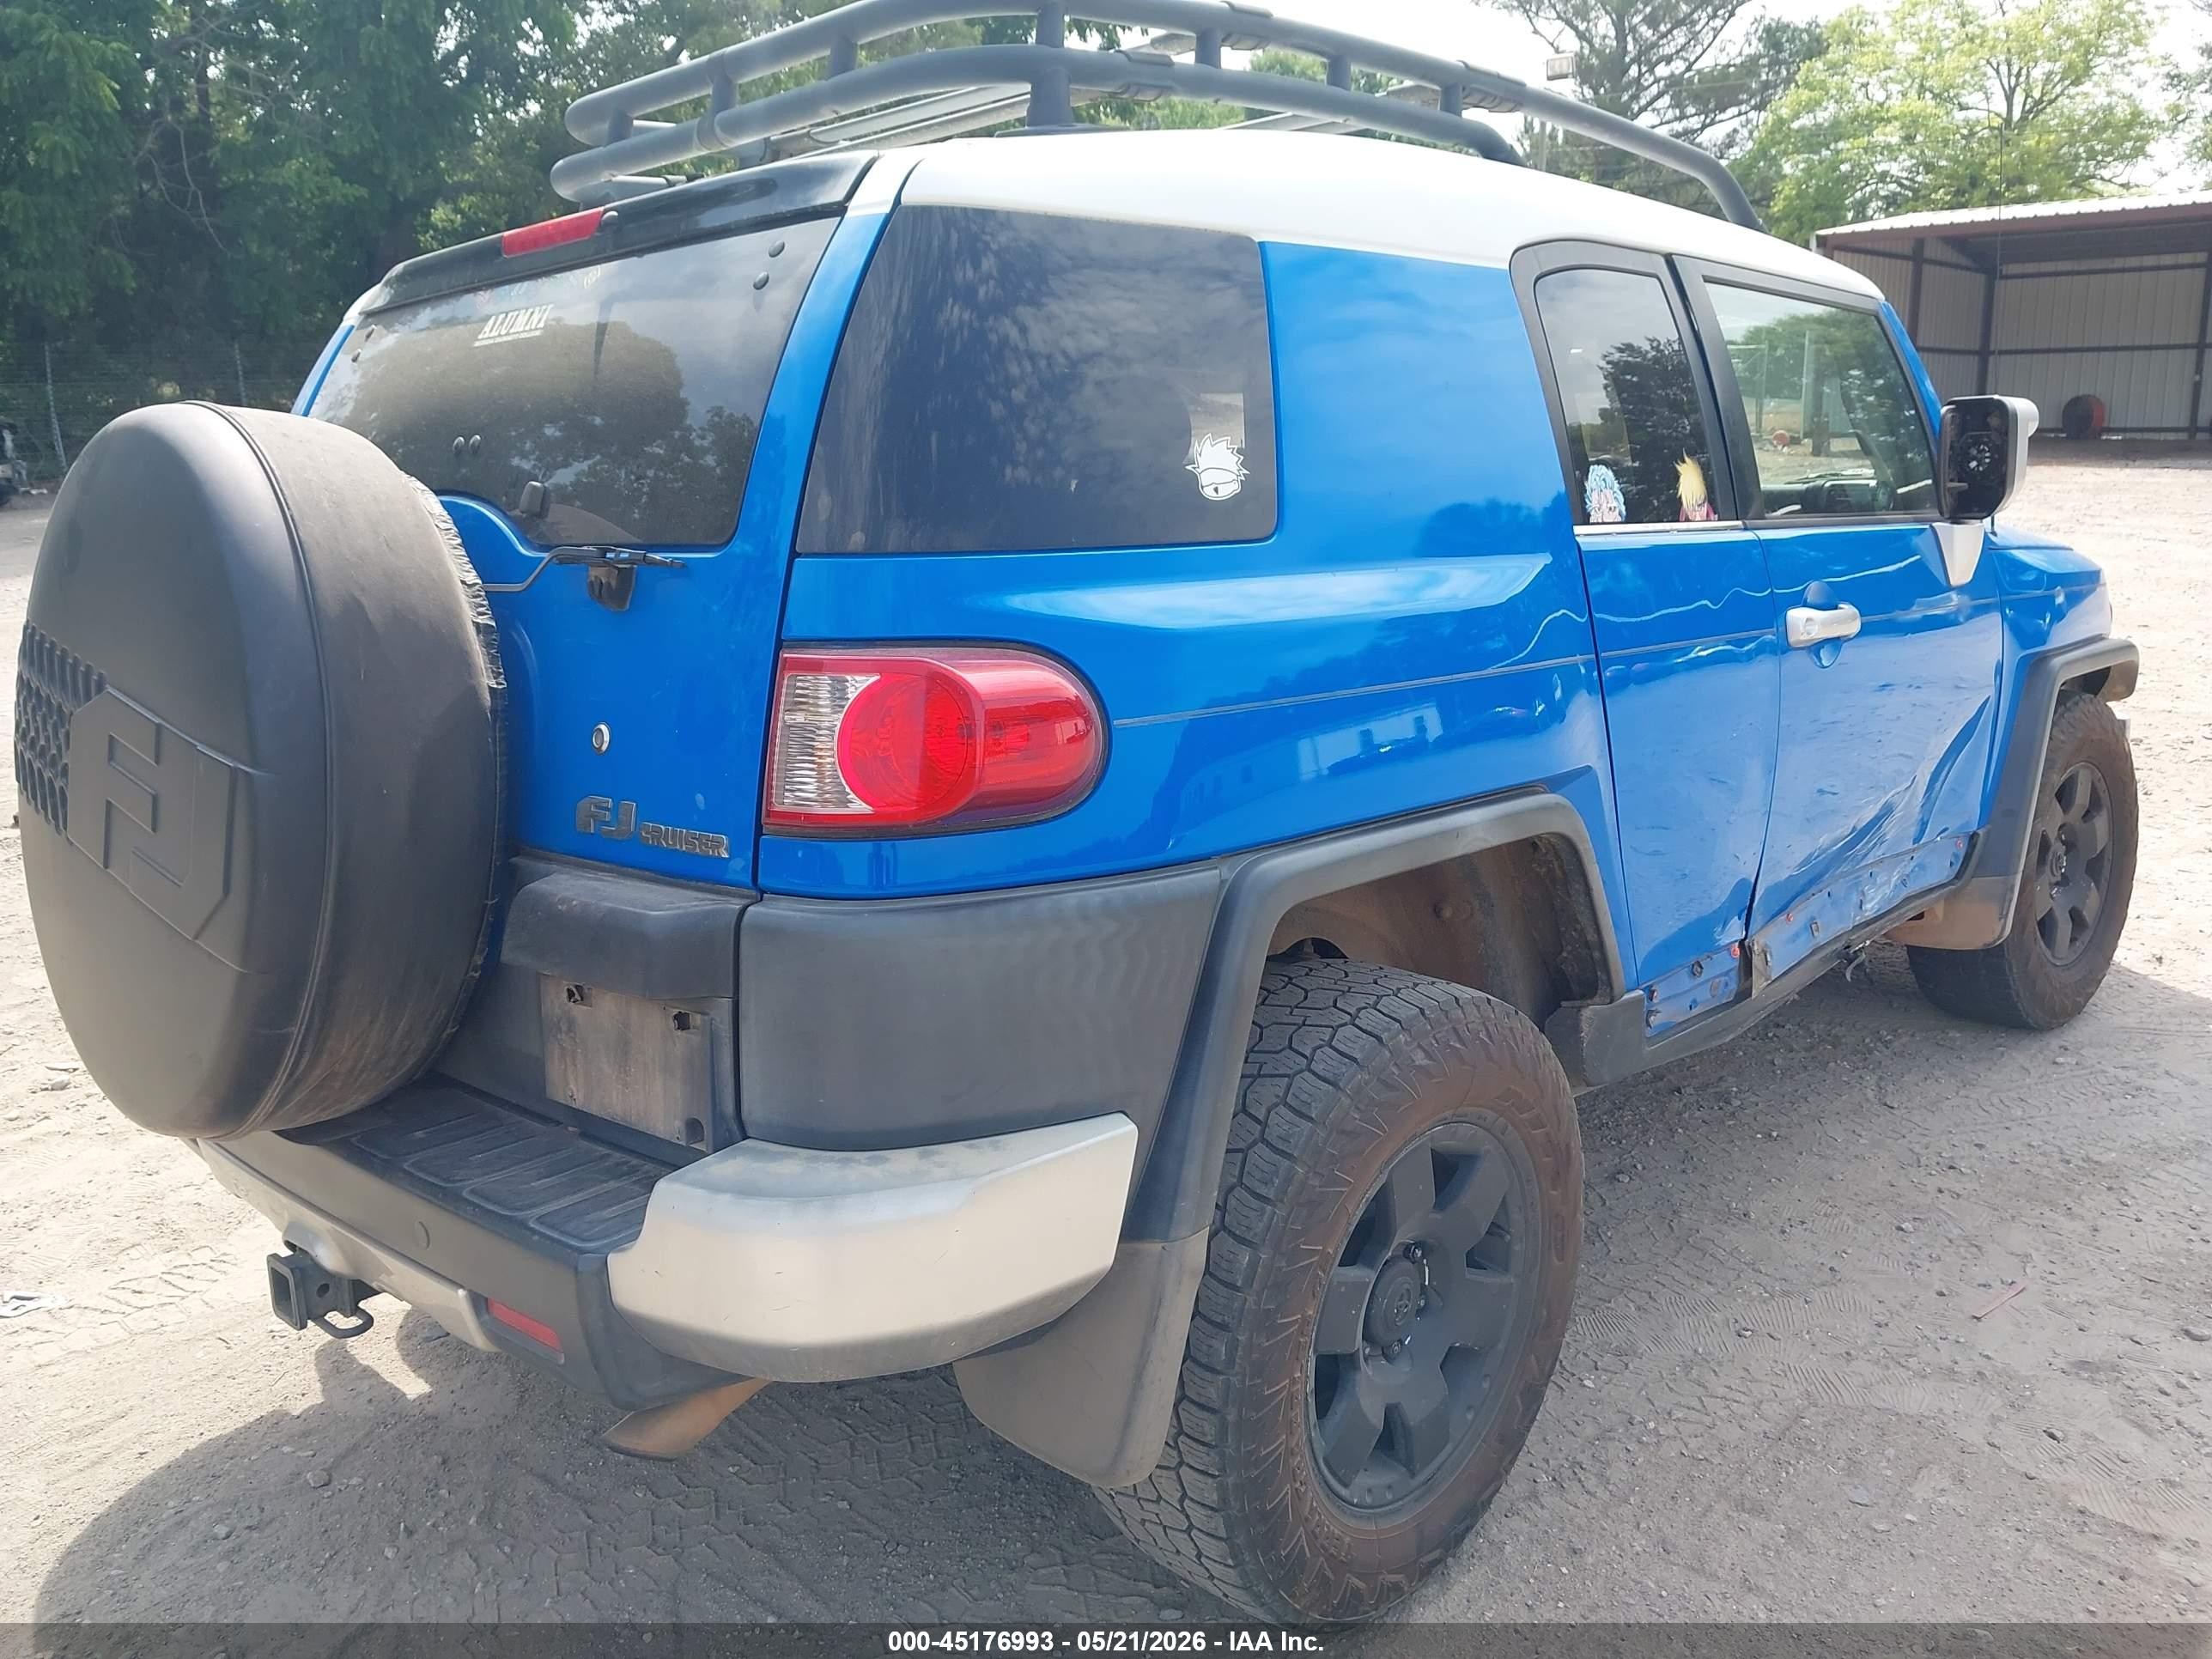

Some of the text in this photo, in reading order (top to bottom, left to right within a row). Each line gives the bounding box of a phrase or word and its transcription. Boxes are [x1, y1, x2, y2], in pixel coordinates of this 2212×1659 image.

[477, 303, 555, 339] ALUMNI
[575, 795, 729, 858] FJ CRUISER
